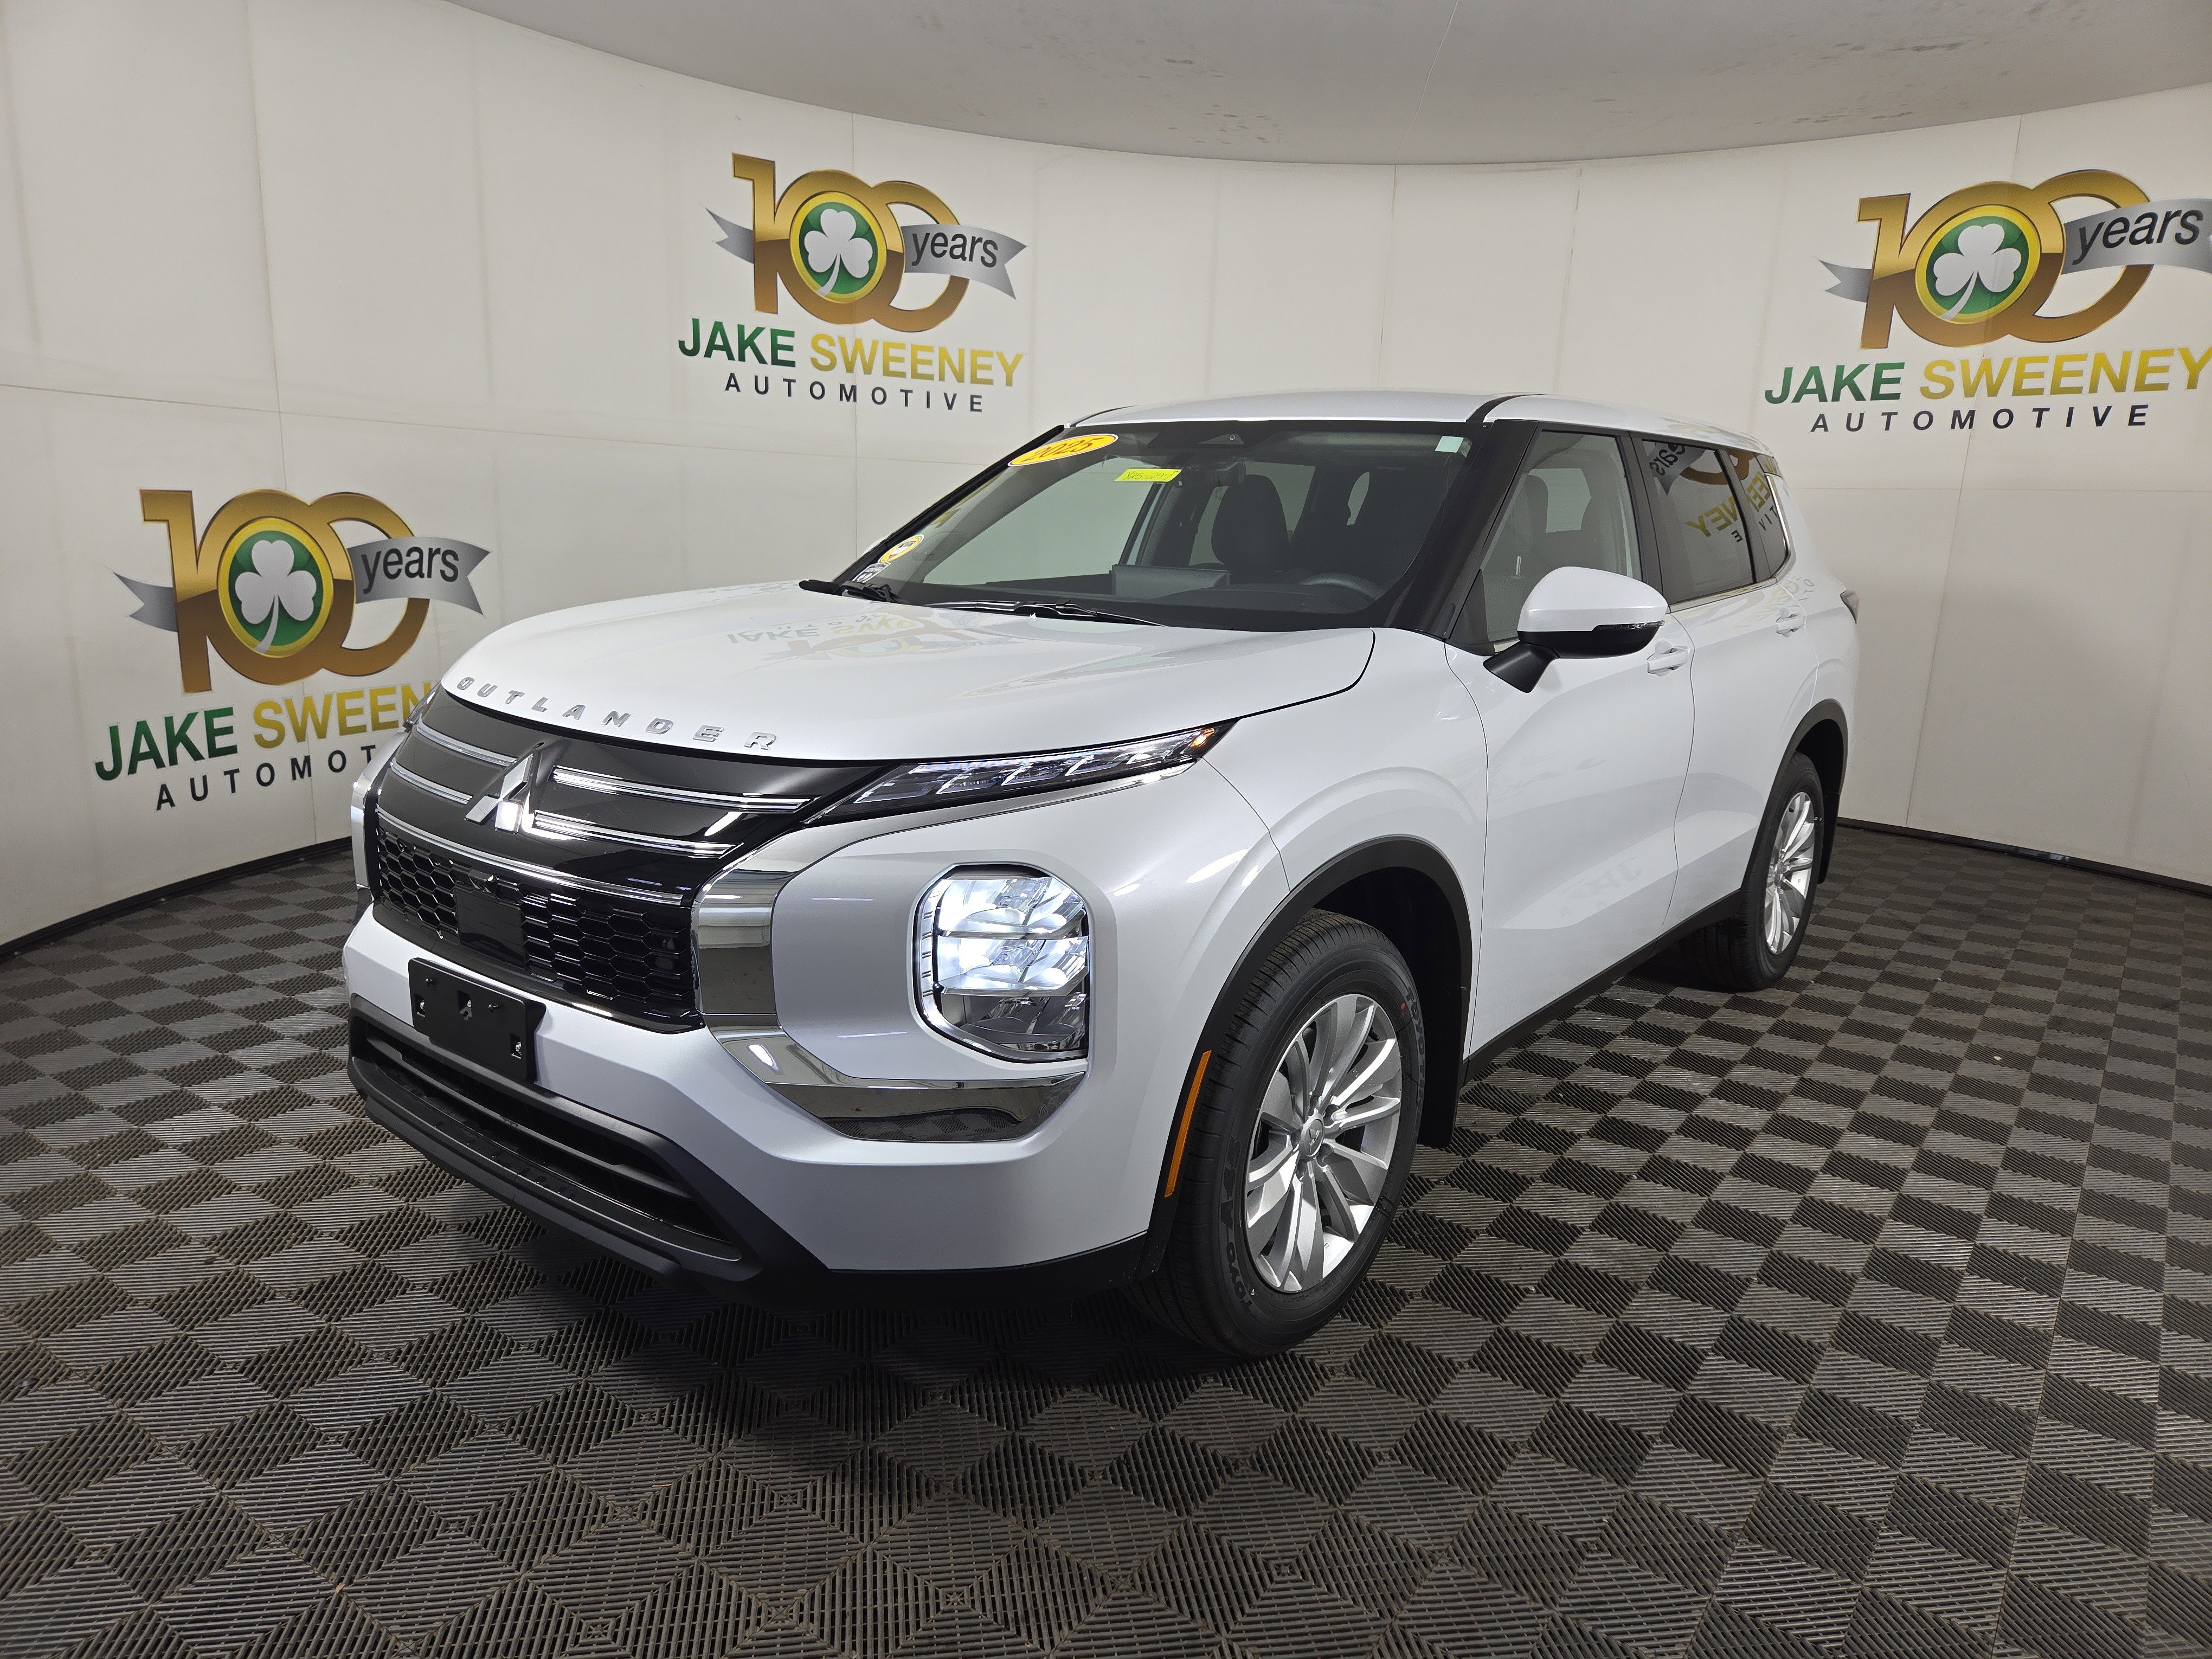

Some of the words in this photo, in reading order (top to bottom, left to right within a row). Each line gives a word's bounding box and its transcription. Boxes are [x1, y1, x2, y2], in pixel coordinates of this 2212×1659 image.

[732, 152, 970, 333] 100
[911, 230, 999, 268] years
[1857, 169, 2153, 350] 100
[2072, 206, 2204, 266] years
[678, 317, 796, 368] JAKE
[809, 332, 1024, 387] SWEENEY
[1764, 362, 1905, 404] JAKE
[1920, 345, 2212, 400] SWEENEY
[724, 372, 983, 413] AUTOMOTIVE
[1810, 404, 2150, 433] AUTOMOTIVE
[1019, 436, 1105, 462] 2025
[139, 488, 431, 694] 100
[361, 546, 459, 595] years
[94, 706, 239, 781] JAKE
[253, 683, 432, 749] SWEEN
[456, 677, 777, 751] OUTLANDER
[155, 744, 376, 812] AUTOMOT
[1225, 1240, 1253, 1314] TOYO
